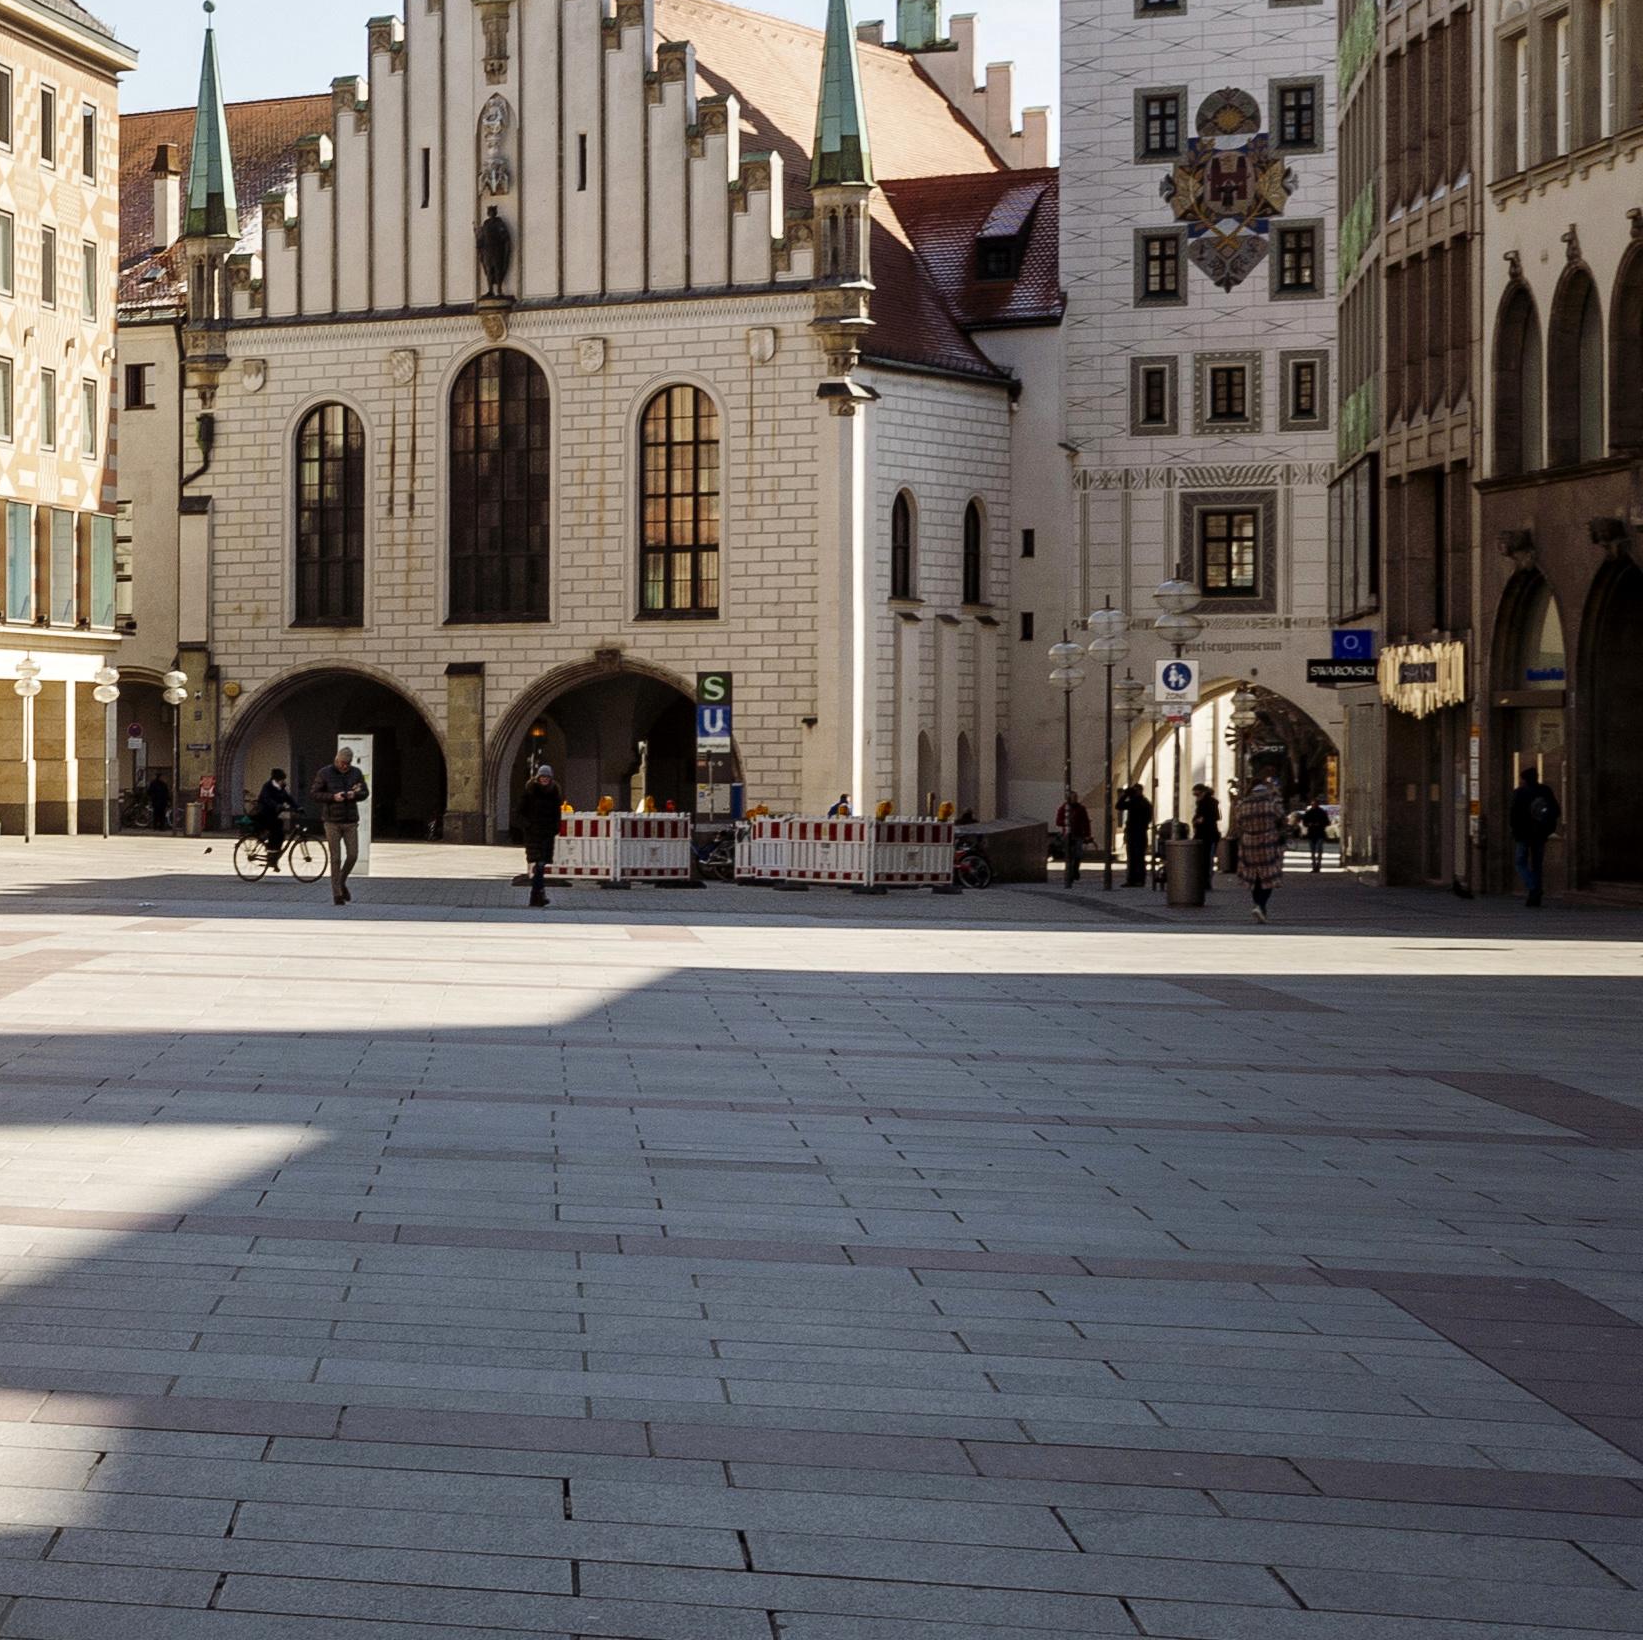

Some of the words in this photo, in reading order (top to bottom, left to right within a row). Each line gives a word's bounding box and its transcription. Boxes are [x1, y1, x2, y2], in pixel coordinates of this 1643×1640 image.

[1184, 641, 1282, 653] pielzeugmuseum
[1310, 665, 1375, 677] SWAROVSKI
[703, 676, 725, 700] S
[703, 709, 724, 733] U
